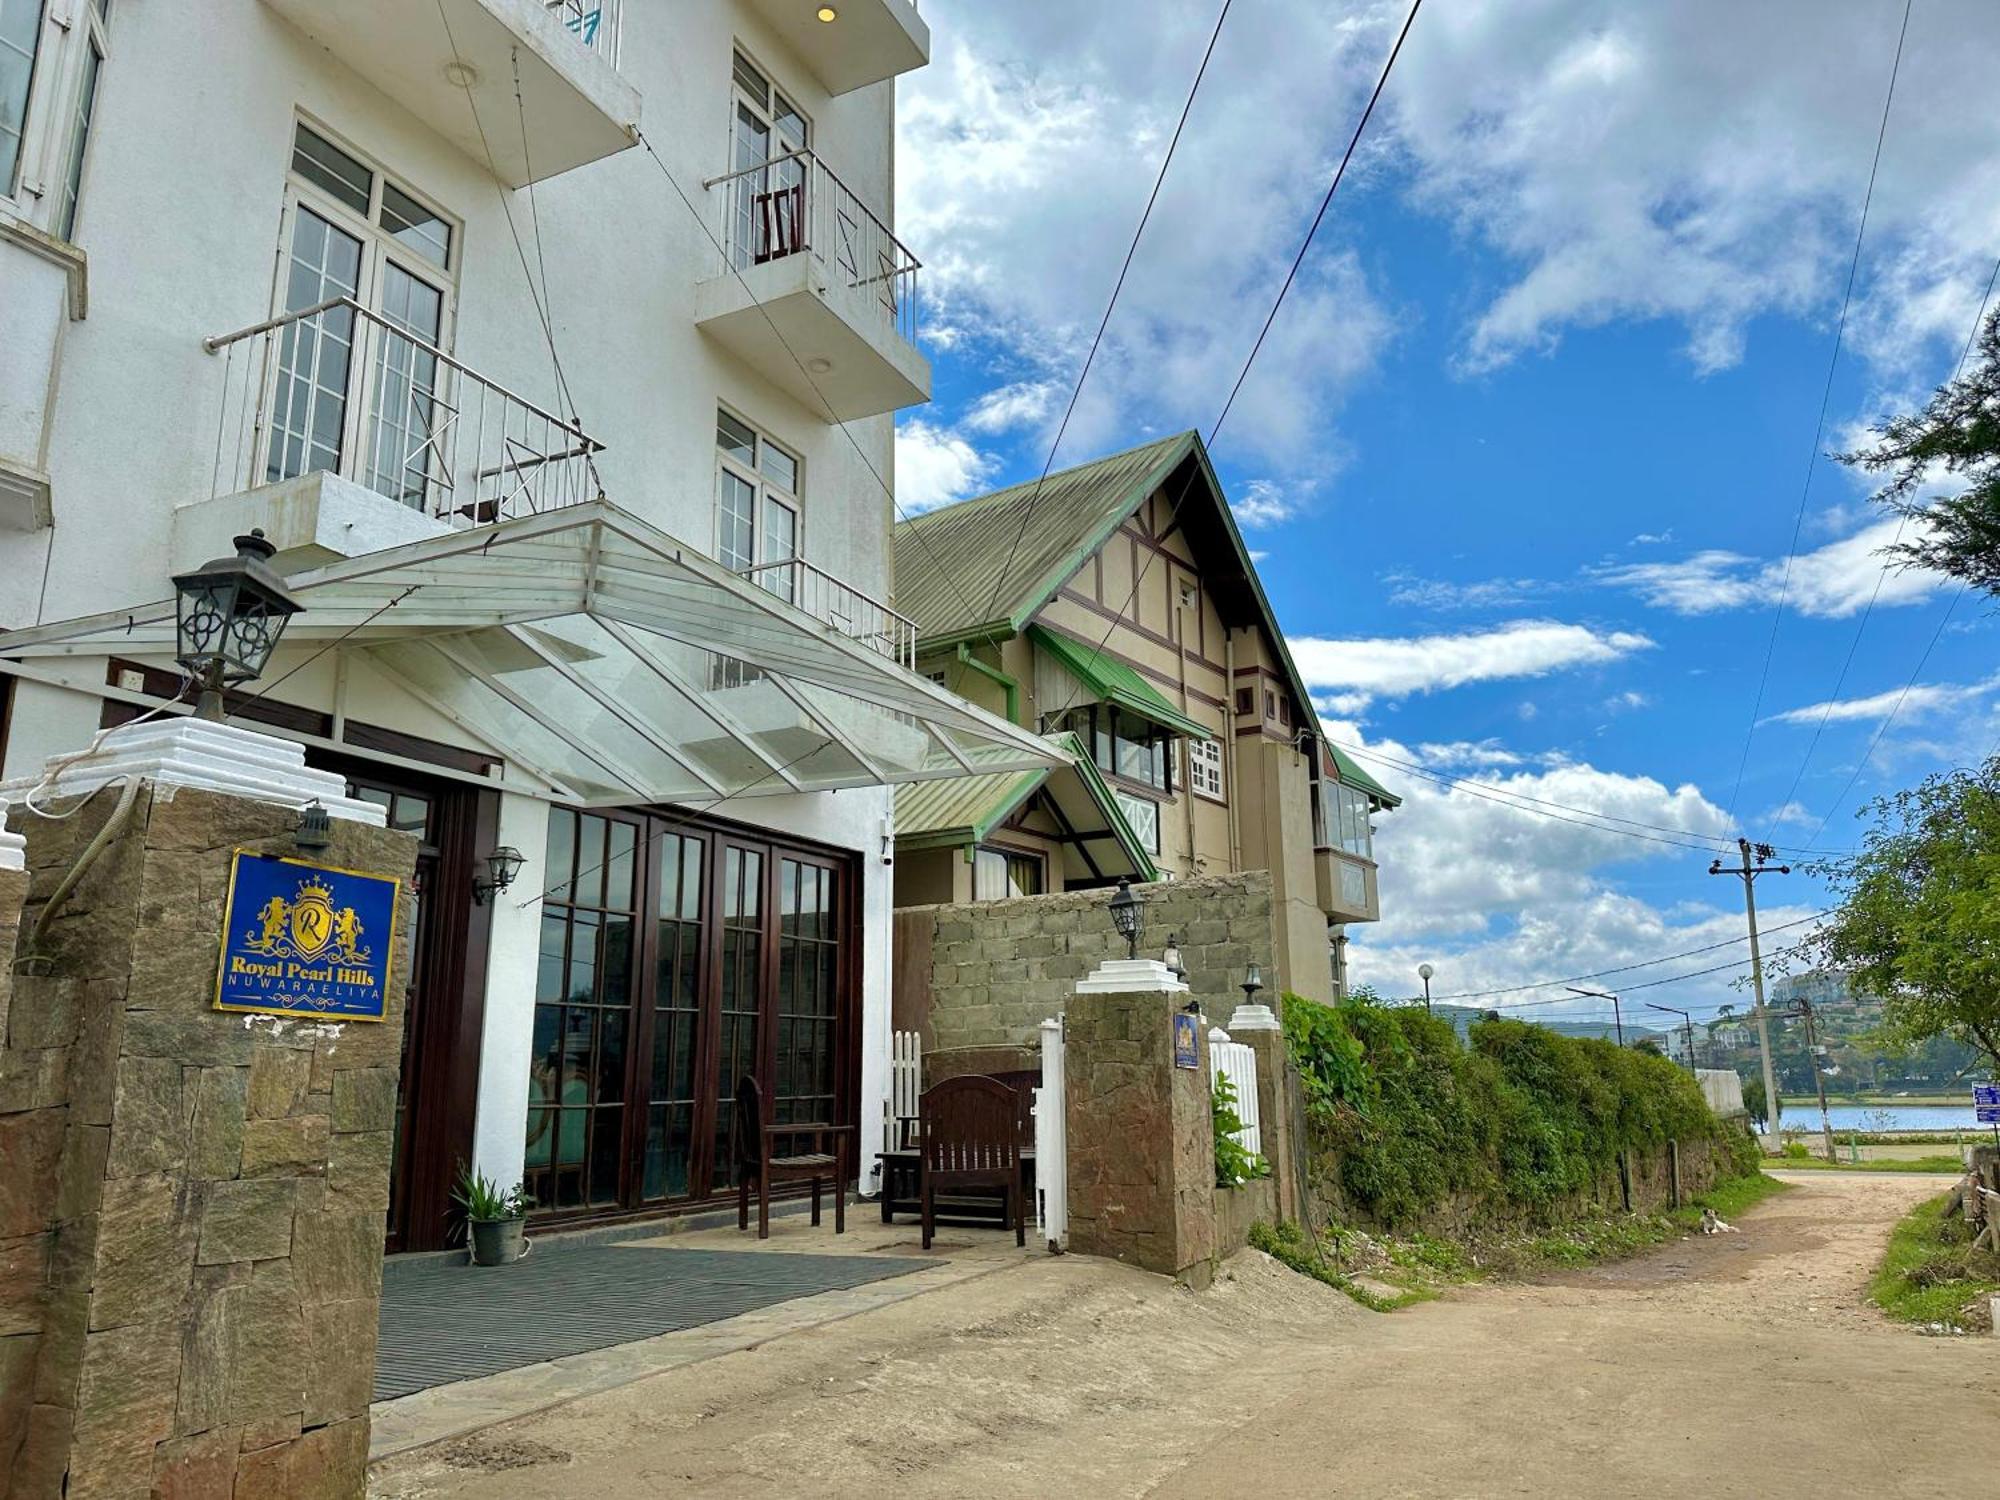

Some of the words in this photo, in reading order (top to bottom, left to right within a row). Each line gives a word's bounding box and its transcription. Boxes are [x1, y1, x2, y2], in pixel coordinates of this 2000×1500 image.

[300, 907, 322, 942] R
[231, 955, 282, 978] Royal
[287, 962, 332, 982] Pearl
[337, 967, 375, 986] Hills
[228, 974, 380, 999] NUWARAELIYA
